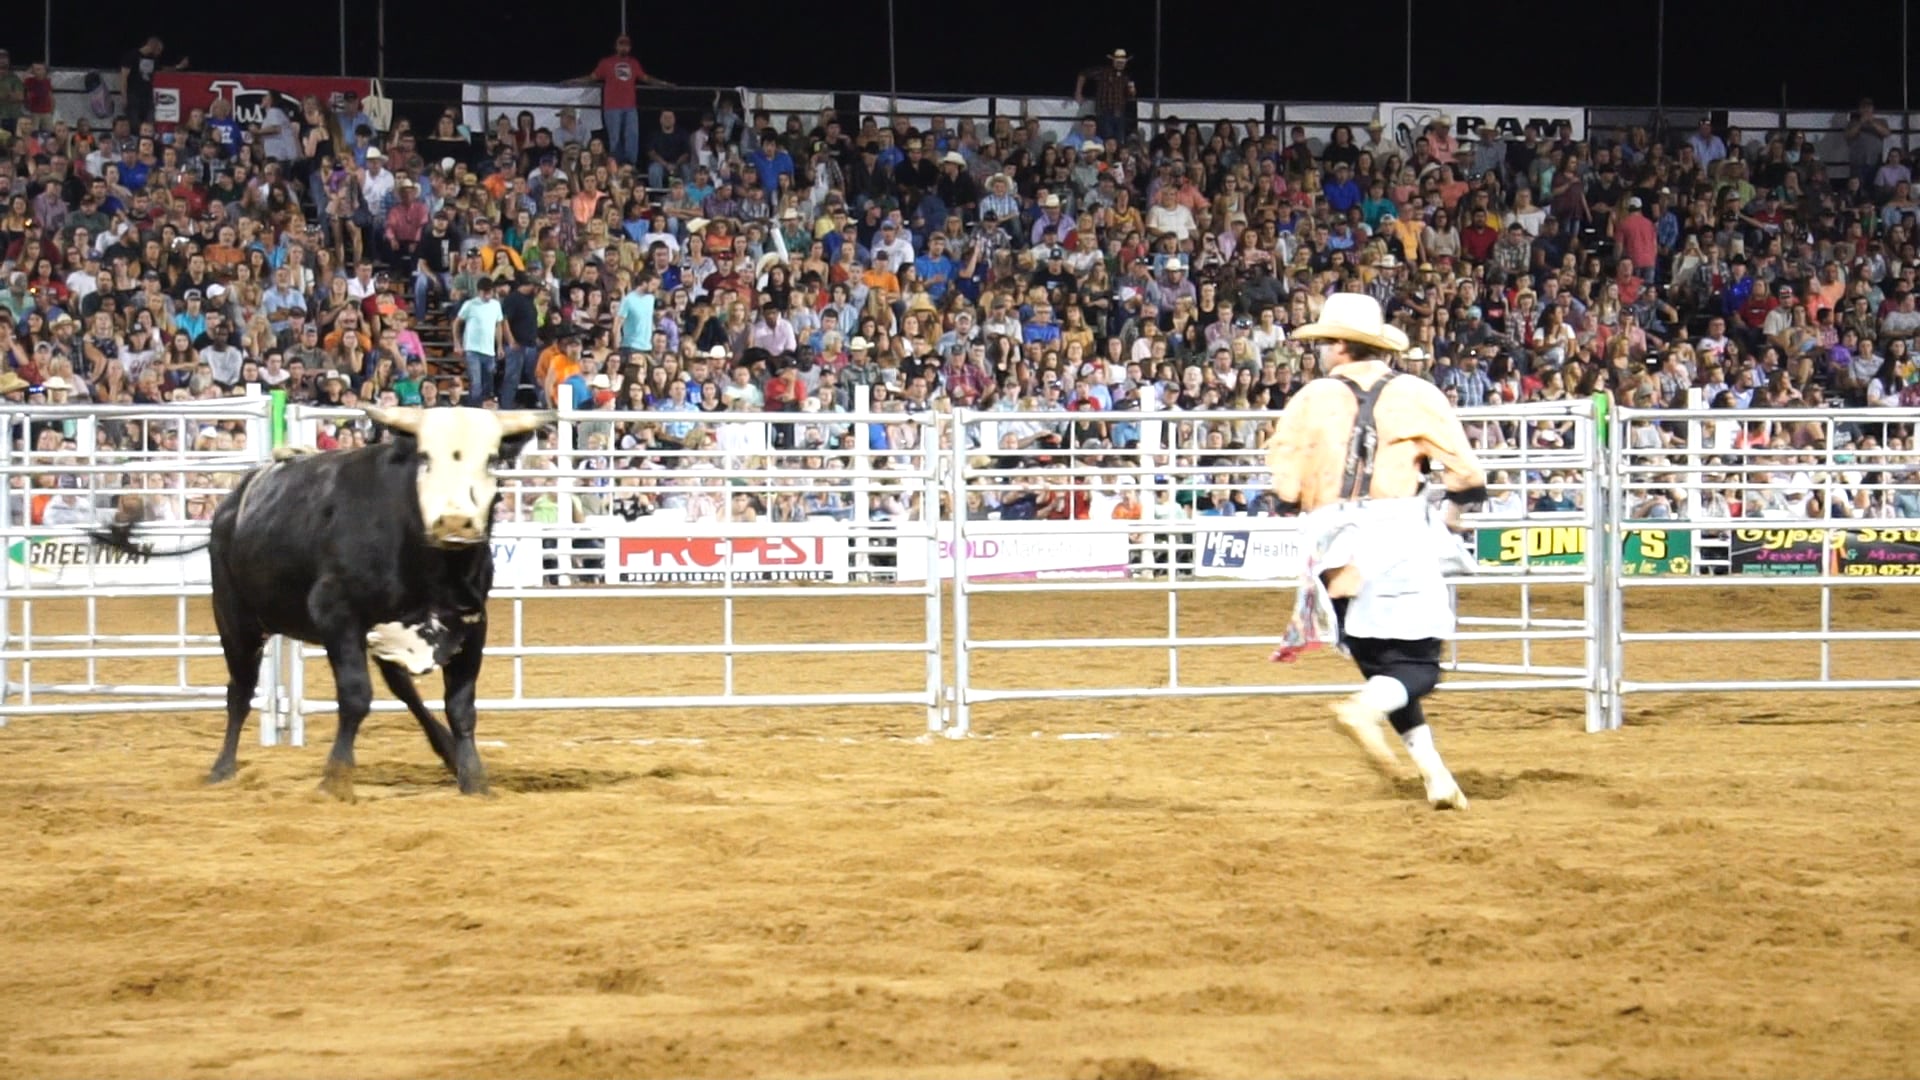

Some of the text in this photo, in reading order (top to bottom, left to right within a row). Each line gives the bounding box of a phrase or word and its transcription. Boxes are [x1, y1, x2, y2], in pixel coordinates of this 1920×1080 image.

[1456, 115, 1572, 138] RAM
[1736, 528, 1847, 550] Gypsy
[938, 540, 999, 559] BOLD
[1756, 548, 1823, 562] Jewelr
